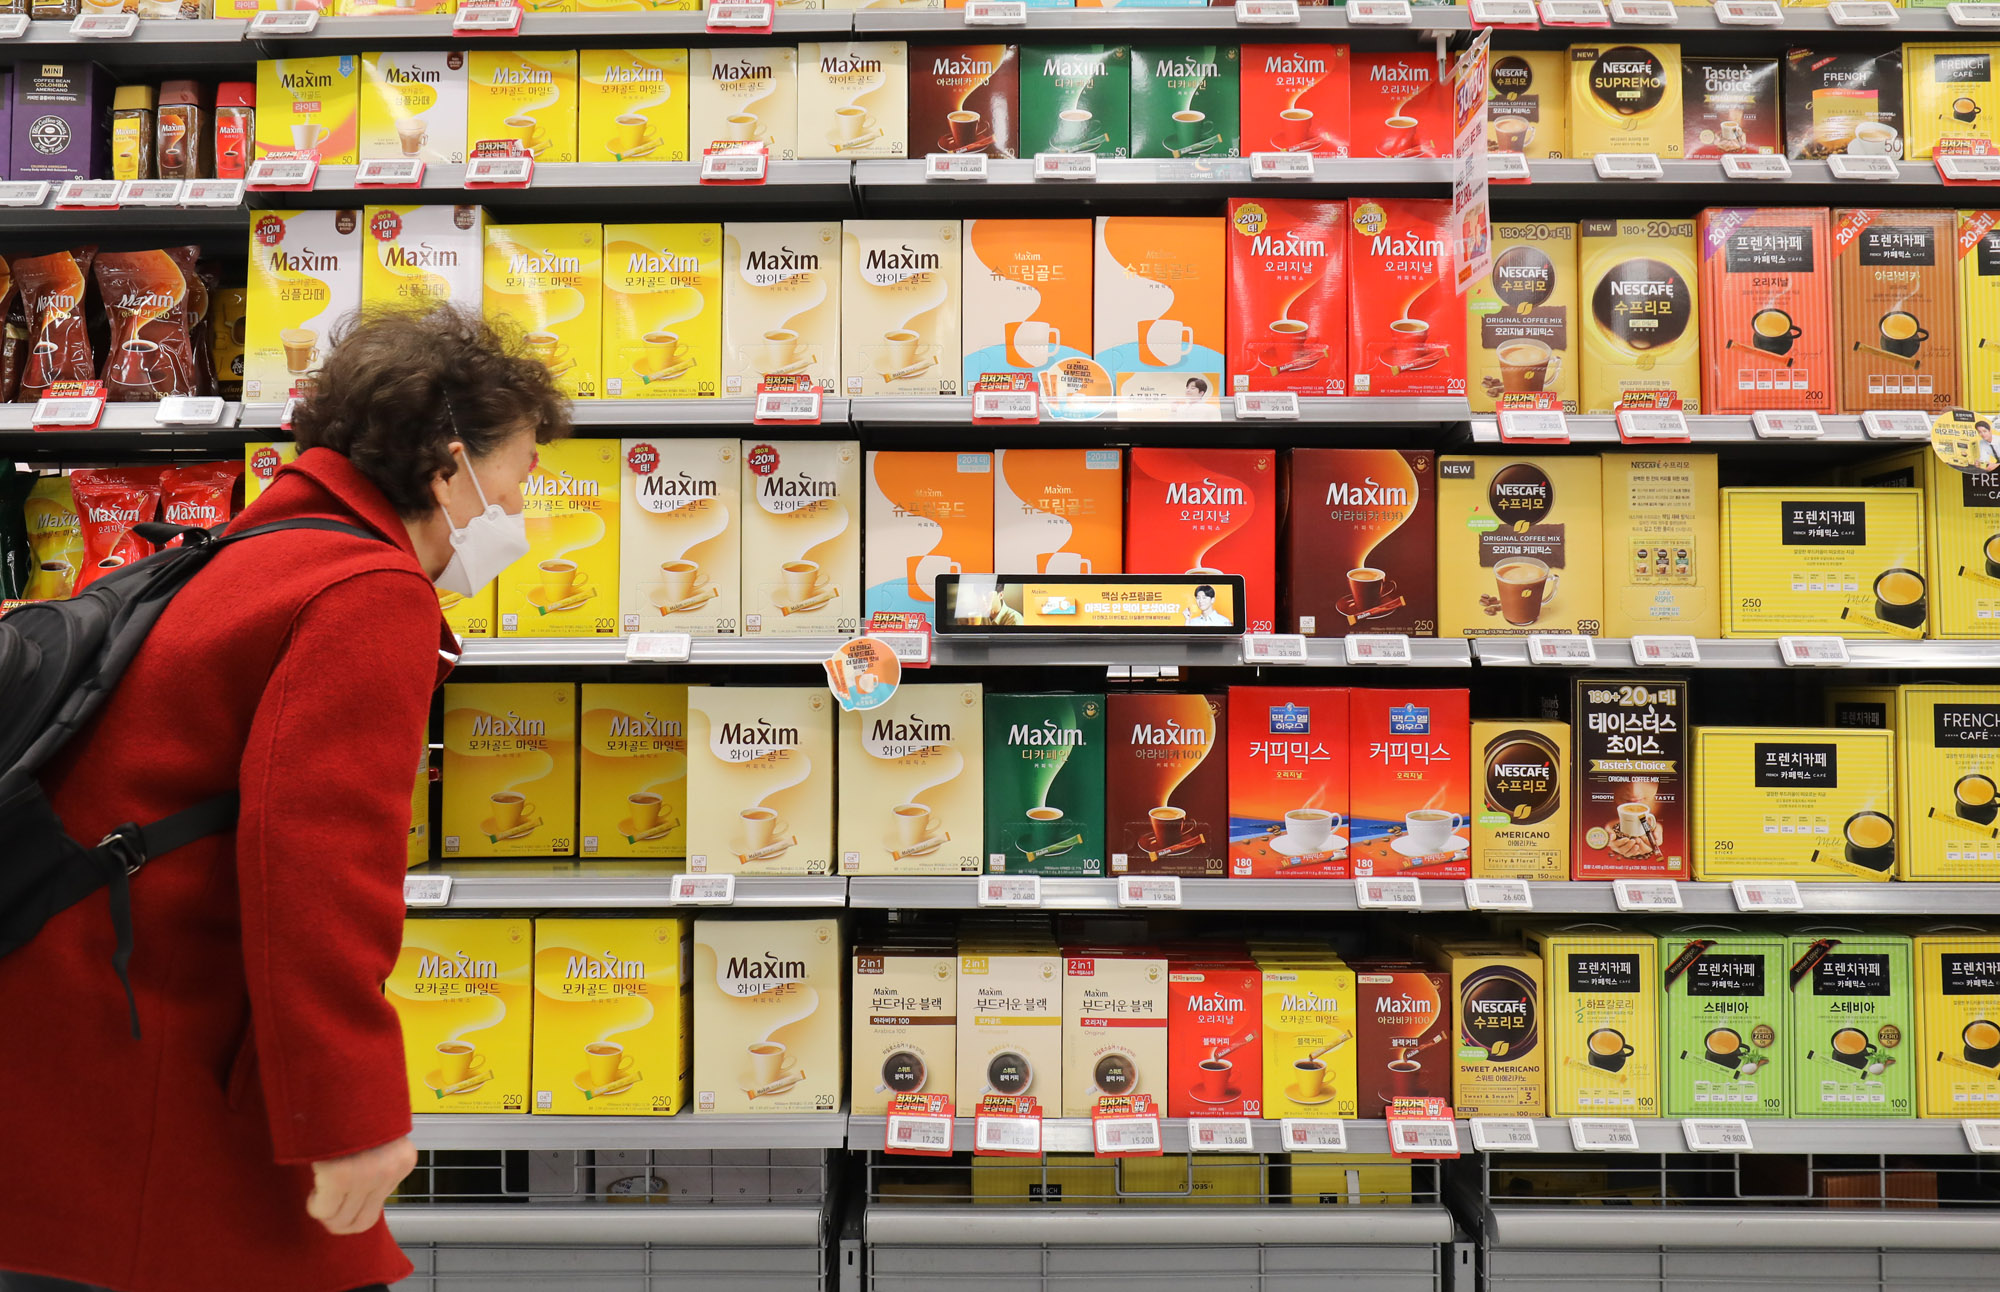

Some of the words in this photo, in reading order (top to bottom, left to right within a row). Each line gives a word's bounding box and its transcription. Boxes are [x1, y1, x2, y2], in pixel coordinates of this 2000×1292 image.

[820, 52, 881, 73] Maxim
[933, 54, 992, 75] Maxim
[1043, 54, 1106, 76] Maxim
[1156, 56, 1219, 77] Maxim
[1265, 52, 1325, 73] Maxim
[1603, 60, 1652, 74] NESCAFÉ
[43, 67, 62, 75] MINI
[385, 65, 440, 83] Maxim
[492, 63, 552, 84] Maxim
[604, 61, 663, 83] Maxim
[712, 59, 772, 80] Maxim
[1370, 61, 1430, 82] Maxim
[1702, 64, 1752, 80] Taster's
[281, 69, 332, 89] Maxim
[1595, 77, 1661, 88] SUPREMO
[1824, 72, 1866, 81] FRENCH
[1705, 79, 1751, 92] Choice
[295, 103, 319, 112] 라이트
[892, 142, 902, 150] 50
[257, 224, 281, 235] +10개
[372, 219, 397, 231] +10개
[1367, 224, 1377, 233] 더!
[1589, 224, 1611, 232] NEW
[382, 230, 392, 239] 더!
[1869, 234, 1925, 248] 프렌치카페
[1250, 231, 1326, 257] Maxim
[1370, 231, 1445, 257] Maxim
[1737, 236, 1802, 251] 프렌치카페
[269, 247, 338, 271] Maxim
[385, 242, 457, 266] Maxim
[508, 248, 579, 273] Maxim
[627, 248, 698, 273] Maxim
[746, 246, 818, 271] Maxim
[866, 244, 939, 269] Maxim
[990, 265, 1064, 282] 슈프림골드
[1264, 261, 1313, 274] 오리지날
[1499, 263, 1548, 280] NESCAFÉ
[506, 277, 547, 288] 모카골드
[551, 276, 582, 287] 마일드
[876, 272, 931, 284] 화이트골드
[1875, 271, 1921, 282] 아라비카
[396, 283, 445, 296] 심플라떼
[1501, 280, 1546, 292] 수프리모
[1611, 277, 1674, 297] NESCAFÉ
[118, 290, 174, 309] Maxim
[279, 288, 324, 301] 심플라떼
[1614, 301, 1672, 315] 수프리모
[698, 382, 714, 391] 100
[939, 380, 956, 390] 100
[1447, 378, 1466, 389] 200
[750, 454, 775, 466] +20개
[1662, 462, 1690, 470] 수프리모
[1444, 465, 1471, 474] NEW
[643, 471, 717, 496] Maxim
[1166, 477, 1244, 505] Maxim
[1326, 477, 1408, 506] Maxim
[1496, 482, 1546, 499] NESCAFÉ
[166, 502, 216, 520] Maxim
[522, 500, 565, 511] 모카골드
[568, 500, 602, 511] 마일드
[892, 501, 967, 518] 슈프림골드
[1021, 498, 1096, 516] 슈프림골드
[1498, 499, 1544, 510] 수프리모
[89, 503, 140, 522] Maxim
[1180, 510, 1231, 523] 오리지날
[1331, 511, 1379, 522] 아라비카
[1380, 511, 1404, 522] 100
[1793, 510, 1855, 526] 프렌치카페
[1101, 592, 1118, 601] 맥심
[1120, 591, 1163, 602] 슈프림골드
[1742, 598, 1762, 608] 250
[1084, 602, 1110, 613] 아직도
[1112, 602, 1122, 613] 안
[1123, 602, 1140, 614] 먹어
[1141, 602, 1180, 614] 보셨어요?
[594, 617, 615, 628] 200
[716, 618, 736, 629] 200
[1252, 621, 1272, 631] 250
[472, 711, 545, 737] Maxim
[609, 712, 682, 737] Maxim
[1588, 704, 1676, 734] 테이스터스
[1840, 712, 1880, 726] 프렌치카페
[720, 717, 798, 745] Maxim
[1960, 729, 1989, 740] CAFÉ
[882, 745, 942, 757] 화이트골드
[1606, 735, 1660, 755] 초이스
[730, 749, 790, 761] 화이트골드
[1022, 749, 1069, 762] 디카페인
[1249, 740, 1331, 765] 커피믹스
[1369, 740, 1451, 766] 커피믹스
[1598, 759, 1632, 770] Taster's
[1635, 761, 1666, 770] Choice
[1765, 752, 1827, 767] 프렌치카페
[1495, 760, 1550, 780] NESCAFÉ
[1496, 780, 1547, 793] 수프리모
[1495, 831, 1550, 839] AMERICANO
[806, 860, 826, 871] 250
[960, 856, 979, 867] 250
[1083, 859, 1100, 870] 100
[1206, 859, 1223, 870] 100
[1236, 858, 1252, 866] 180
[417, 950, 497, 979] Maxim
[566, 950, 645, 979] Maxim
[726, 951, 806, 979] Maxim
[860, 959, 866, 968] 2
[868, 959, 876, 968] in
[878, 959, 881, 968] 1
[1578, 962, 1631, 975] 프렌치카페
[1698, 962, 1755, 976] 프렌치카페
[1823, 962, 1880, 976] 프렌치카페
[414, 983, 462, 995] 모카골드
[466, 982, 501, 994] 마일드
[562, 984, 610, 996] 모카골드
[613, 983, 648, 995] 마일드
[737, 983, 797, 995] 화이트골드
[869, 998, 917, 1011] 부드러운
[919, 997, 942, 1011] 블랙
[1083, 999, 1129, 1013] 부드러운
[1131, 999, 1153, 1012] 블랙
[1187, 991, 1246, 1012] Maxim
[1281, 991, 1338, 1012] Maxim
[1376, 992, 1433, 1013] Maxim
[1586, 999, 1634, 1010] 하프칼로리
[1704, 1002, 1749, 1014] 스테비아
[1830, 1002, 1875, 1014] 스테비아
[1197, 1014, 1234, 1024] 오리지날
[1378, 1016, 1412, 1025] 아라비카
[1414, 1016, 1430, 1025] 100
[1474, 1015, 1525, 1029] 수프리모
[503, 1094, 522, 1105] 250
[652, 1096, 672, 1107] 250
[815, 1095, 835, 1106] 250
[897, 1094, 928, 1103] 최저가격
